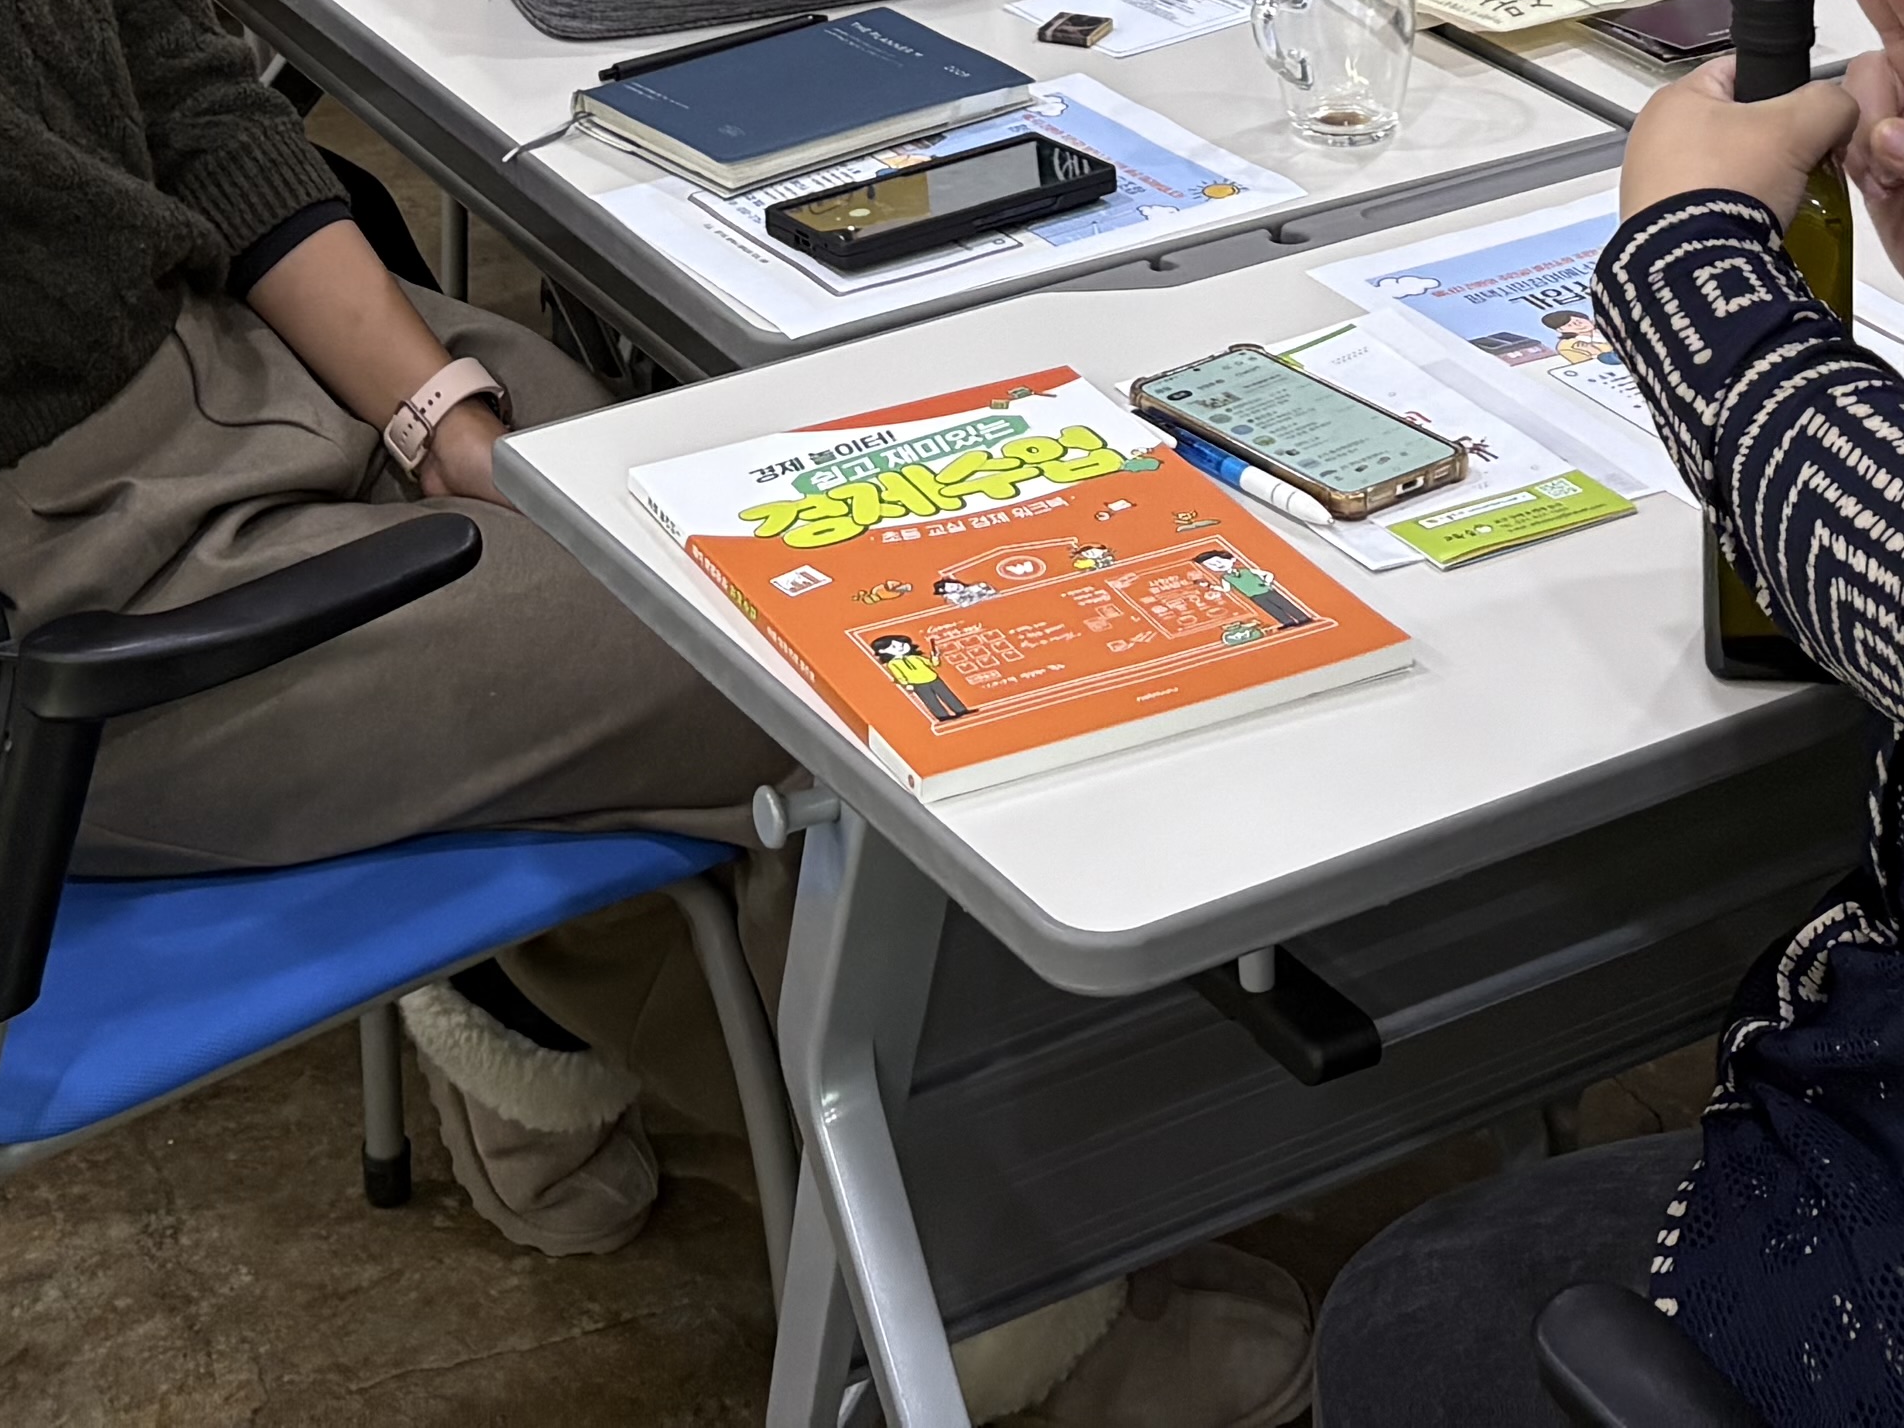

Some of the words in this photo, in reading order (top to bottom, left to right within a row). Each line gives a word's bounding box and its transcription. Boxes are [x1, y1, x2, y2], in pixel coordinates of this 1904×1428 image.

[738, 424, 1127, 550] 경제수업
[749, 450, 806, 485] 경제
[808, 429, 896, 467] 놀이터!
[810, 457, 881, 492] 쉽고
[885, 421, 1016, 469] 재미있는
[881, 523, 922, 544] 초등
[926, 516, 967, 538] 교실
[968, 510, 1011, 532] 경제
[1013, 496, 1069, 522] 워크북
